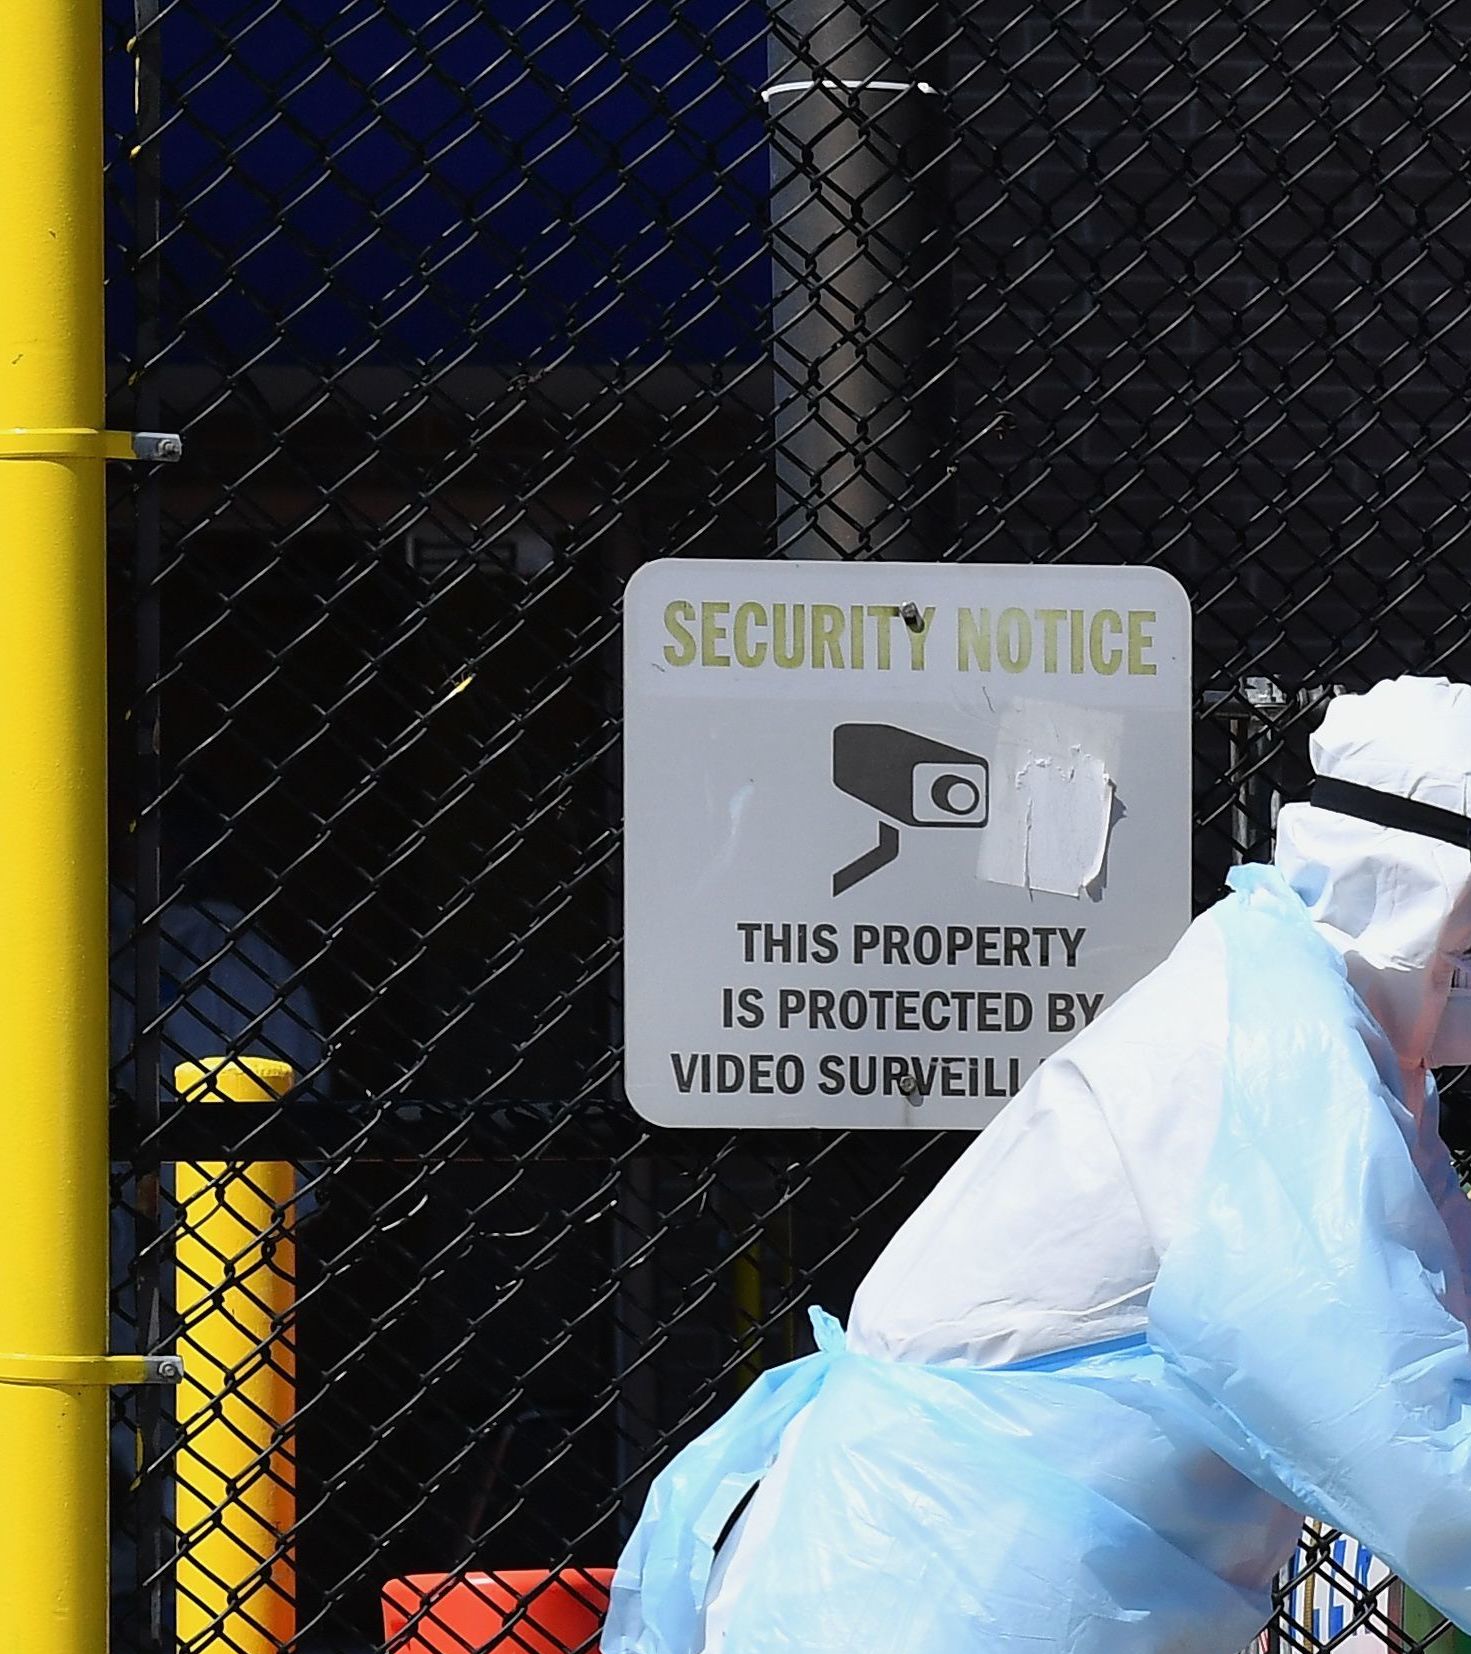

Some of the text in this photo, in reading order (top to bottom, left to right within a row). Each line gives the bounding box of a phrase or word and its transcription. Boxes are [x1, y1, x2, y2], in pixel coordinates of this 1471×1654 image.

[663, 600, 1158, 676] SECURITY NOTICE
[737, 922, 1087, 968] THIS PROPERTY
[721, 987, 1105, 1033] IS PROTECTED BY
[671, 1053, 1046, 1098] VIDEO SURVEILL
